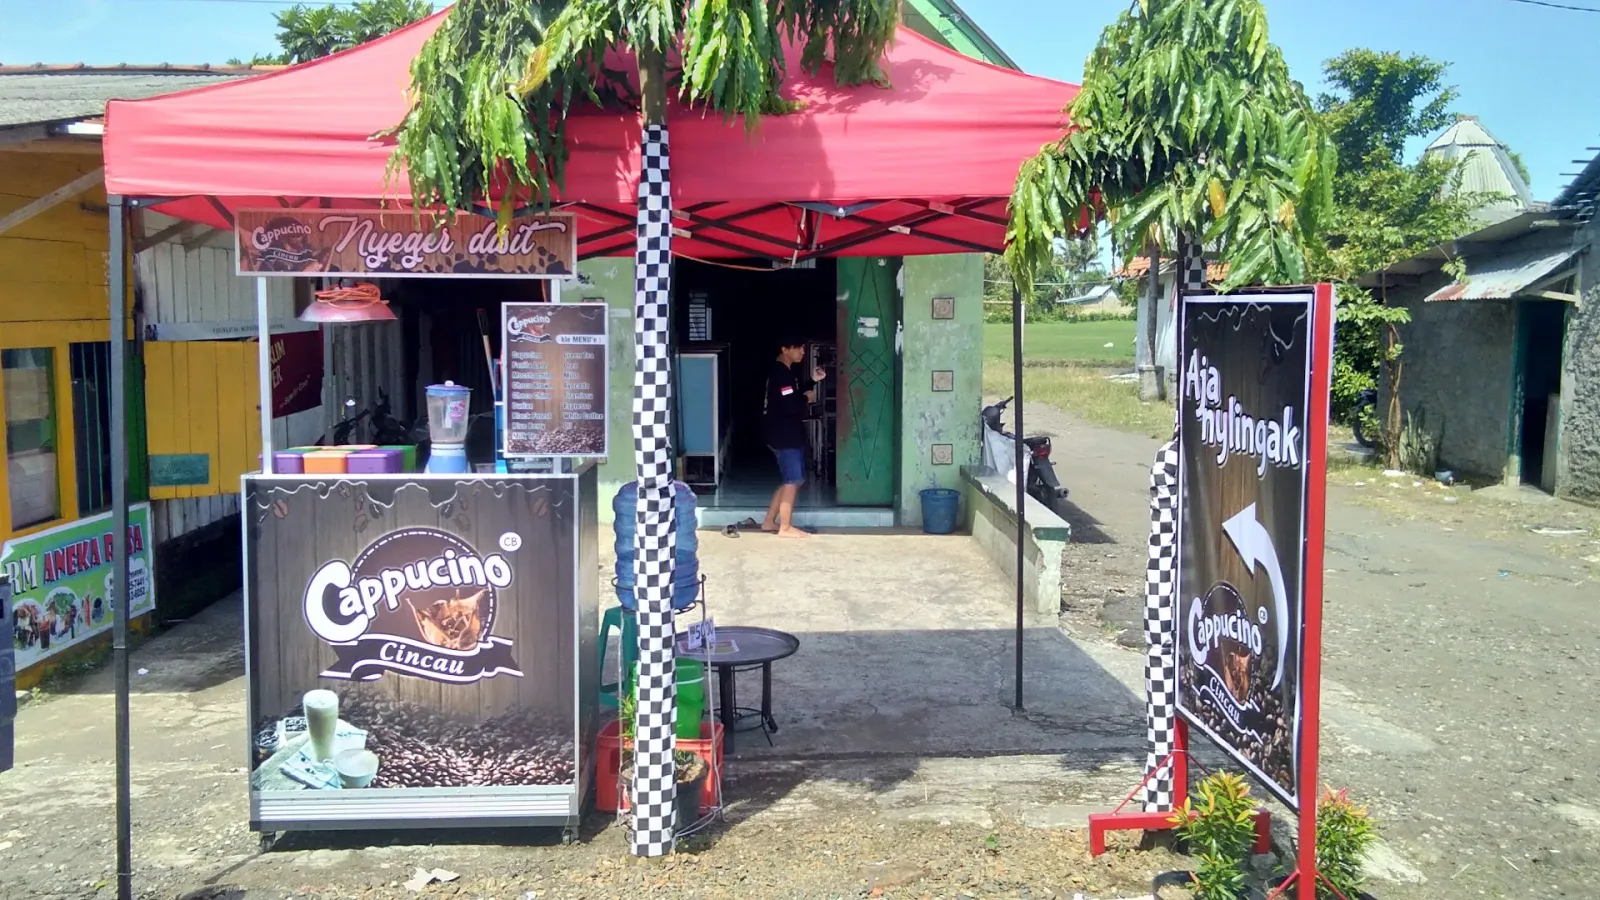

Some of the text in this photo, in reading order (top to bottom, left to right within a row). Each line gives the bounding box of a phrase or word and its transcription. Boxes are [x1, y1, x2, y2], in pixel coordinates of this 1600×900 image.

[252, 214, 311, 250] Cappucino
[318, 215, 455, 269] Nyeger
[508, 316, 550, 335] Cappucino
[1186, 348, 1222, 419] Aja
[1201, 395, 1299, 478] nylingak
[4, 555, 37, 595] RM
[44, 537, 103, 585] ANEKA
[503, 538, 517, 546] CB
[304, 549, 512, 643] Cappucino
[1188, 597, 1262, 665] Cappucino
[379, 642, 465, 675] Cincau
[1209, 676, 1240, 724] Cincau
